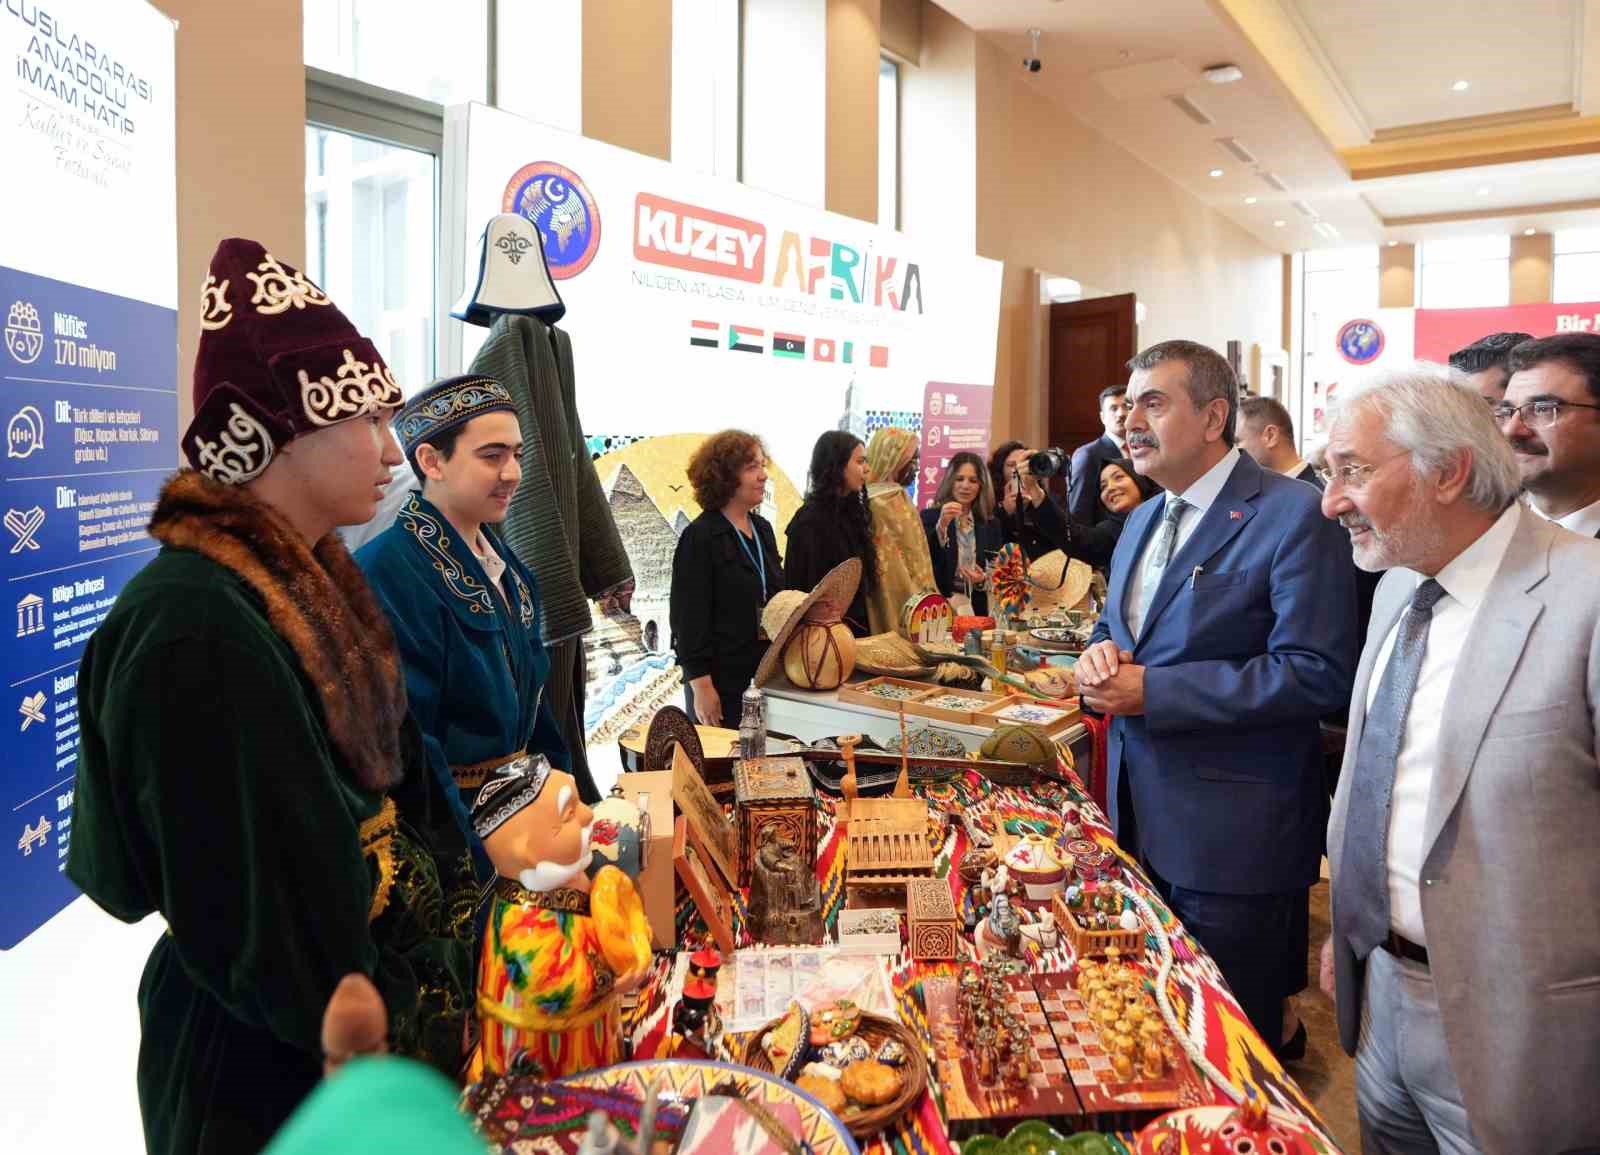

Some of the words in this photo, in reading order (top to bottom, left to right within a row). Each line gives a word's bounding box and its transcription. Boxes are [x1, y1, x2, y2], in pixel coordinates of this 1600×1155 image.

[0, 0, 152, 104] LUSLARARASI
[27, 35, 127, 109] ANADOLU
[637, 204, 764, 269] KUZEY
[772, 230, 924, 316] AFRİKA
[1556, 314, 1591, 332] Bir
[54, 339, 75, 366] 170
[79, 344, 116, 372] milyon
[56, 486, 77, 509] Din:
